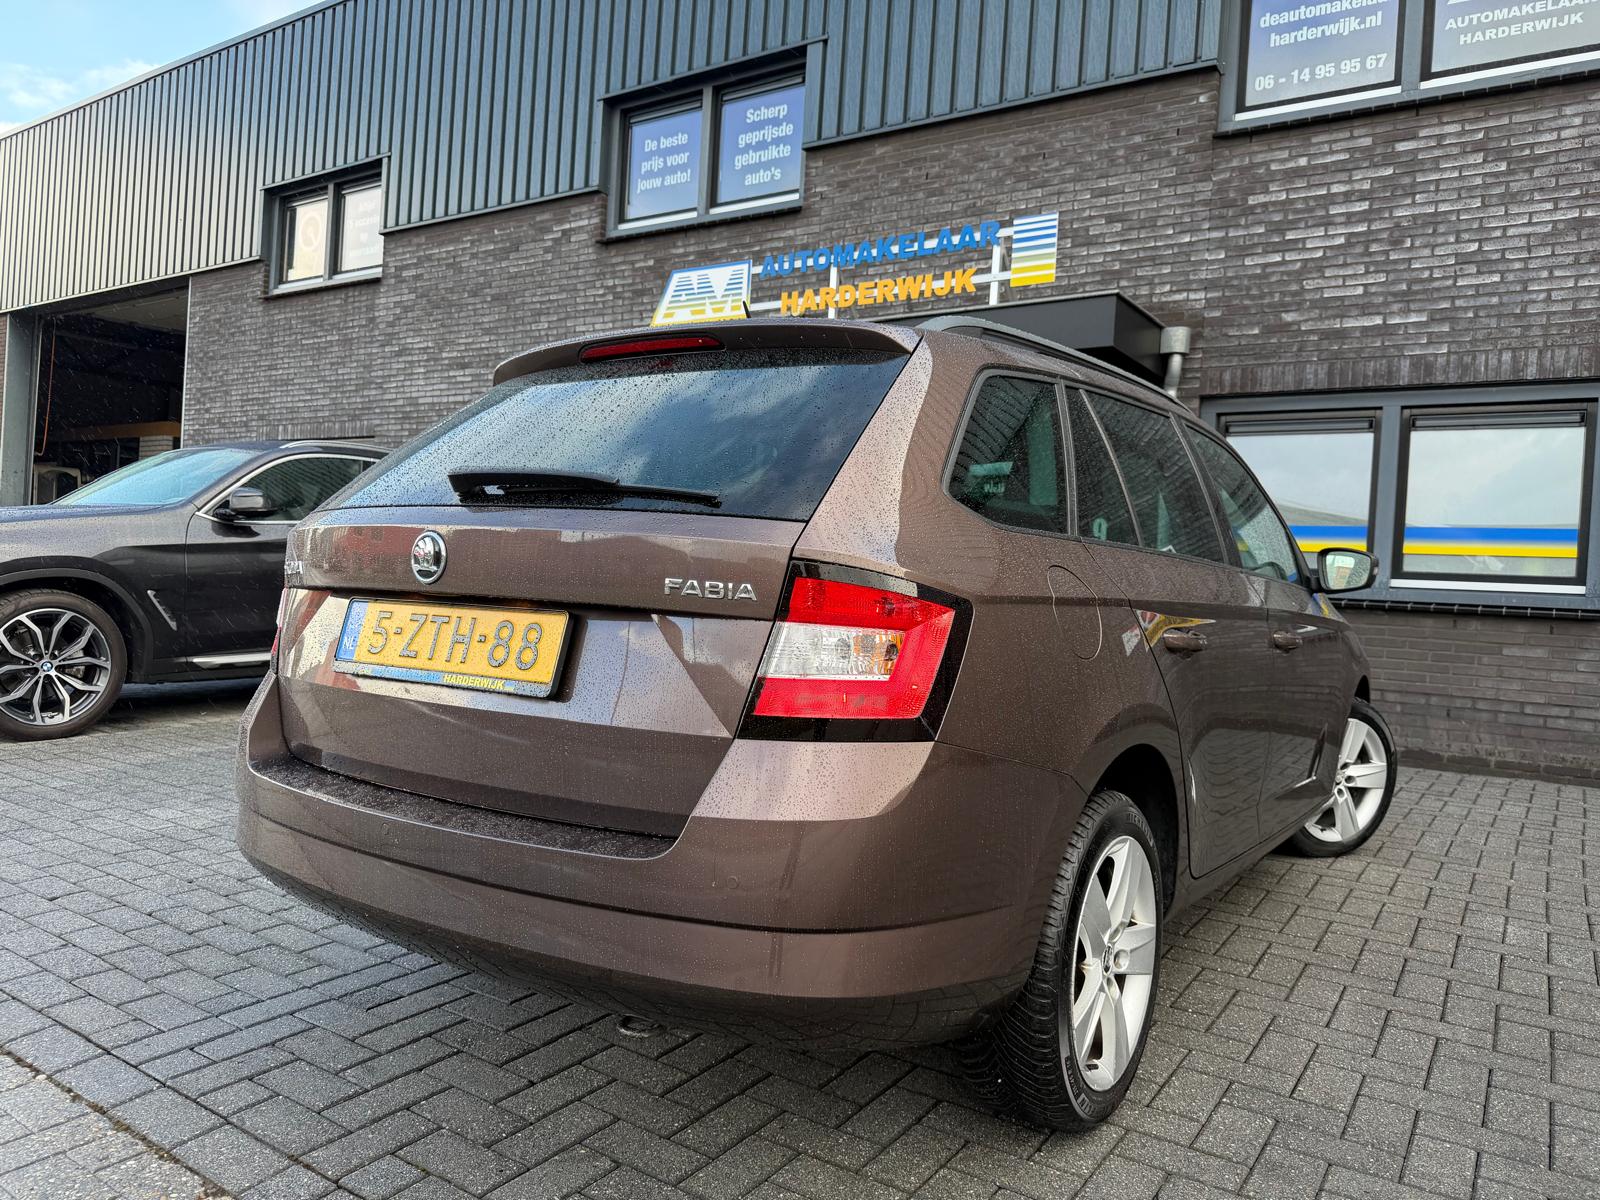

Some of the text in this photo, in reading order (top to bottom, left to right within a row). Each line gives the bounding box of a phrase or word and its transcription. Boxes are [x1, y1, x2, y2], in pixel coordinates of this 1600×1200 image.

[1260, 0, 1388, 28] deautomake
[1445, 0, 1598, 30] AUTOMAKELAA
[1269, 11, 1383, 48] harderwijk.nl
[1459, 12, 1584, 45] HARDERWIJK
[1254, 74, 1275, 91] 06
[1291, 67, 1311, 84] 14
[1315, 63, 1335, 79] 95
[1340, 58, 1361, 74] 95
[1365, 53, 1388, 70] 67
[746, 104, 788, 123] Scherp
[644, 132, 689, 152] De beste
[738, 122, 794, 148] geprijsde
[641, 151, 690, 175] prijs voor
[735, 144, 791, 170] gebruikte
[637, 168, 691, 194] jouw auto!
[744, 167, 781, 186] auto's
[759, 220, 1001, 280] AUTOMAKELAAR
[780, 267, 978, 316] HARDERWIJK
[664, 578, 757, 601] FABIA
[342, 636, 355, 651] NL
[367, 610, 543, 670] 5-ZTH-88
[443, 674, 506, 690] HARDERWIJK
